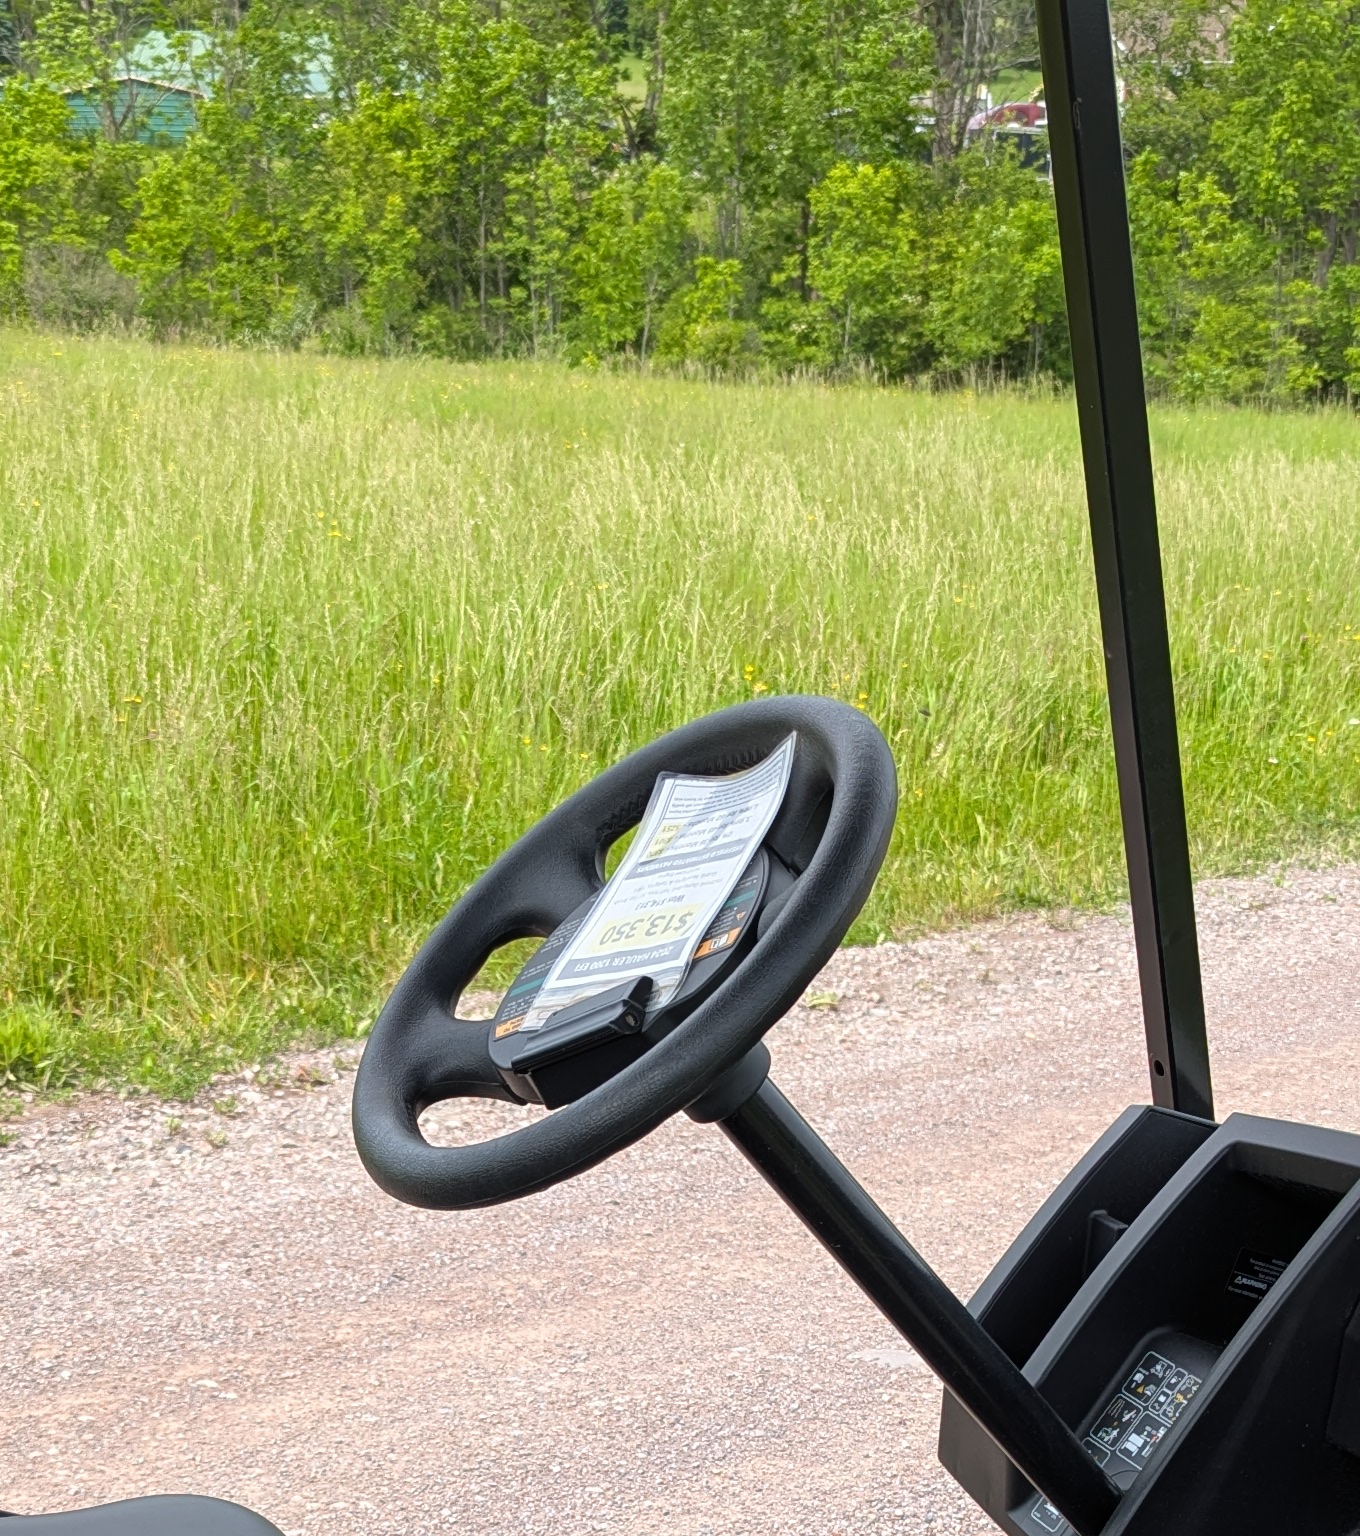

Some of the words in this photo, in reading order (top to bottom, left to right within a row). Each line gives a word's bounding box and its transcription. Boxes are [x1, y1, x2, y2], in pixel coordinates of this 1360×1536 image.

[667, 894, 685, 904] Was
[599, 910, 693, 946] $13,350
[650, 945, 674, 959] 2024
[591, 958, 611, 969] 1200
[612, 952, 650, 967] HAULER
[574, 962, 589, 972] EFI
